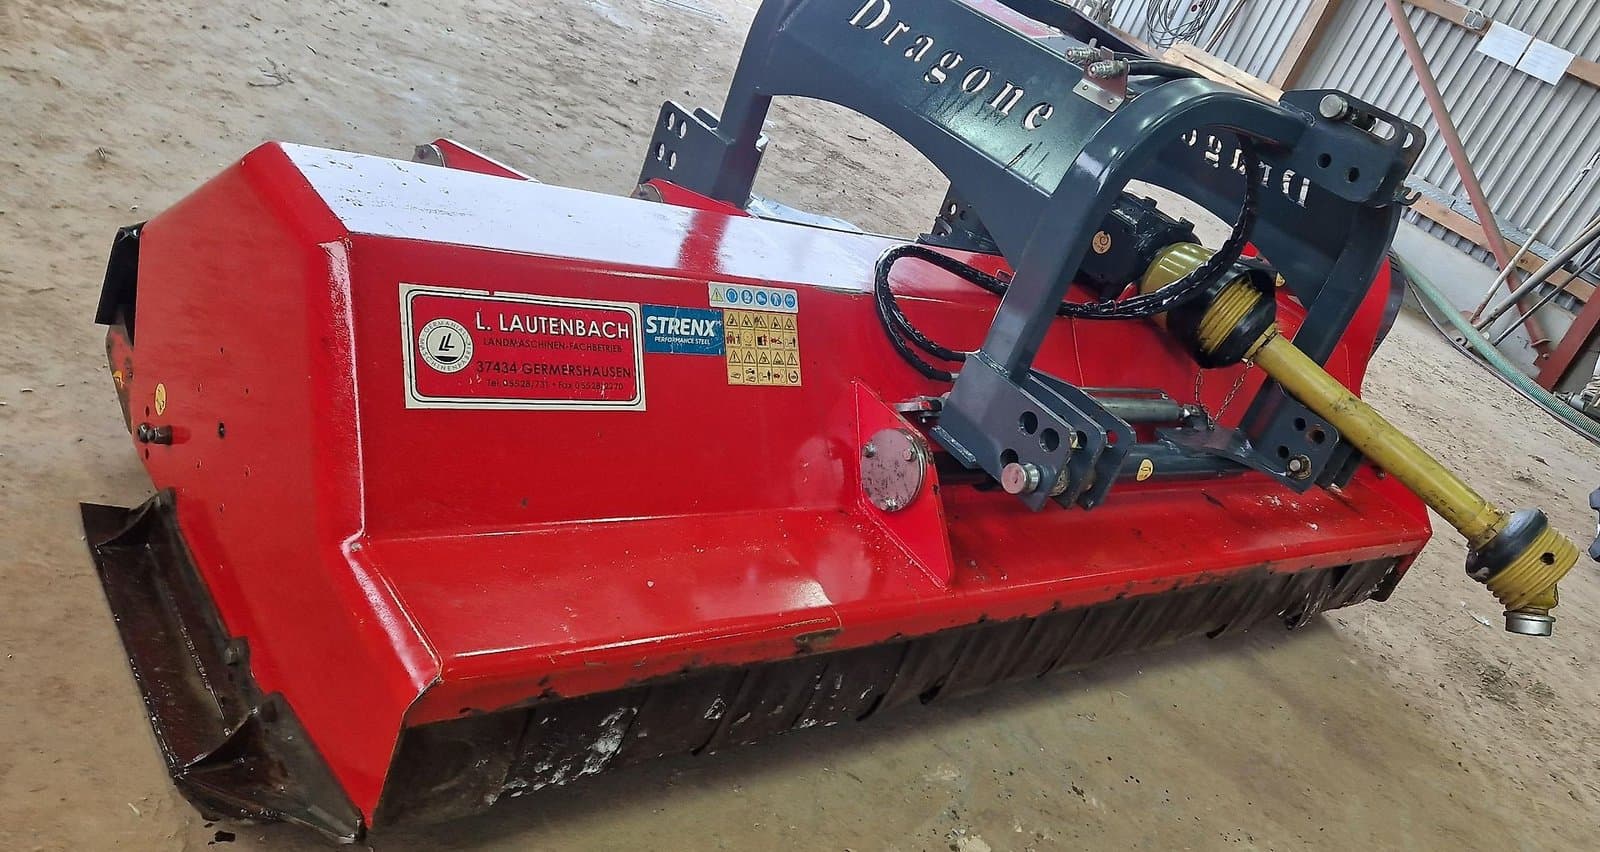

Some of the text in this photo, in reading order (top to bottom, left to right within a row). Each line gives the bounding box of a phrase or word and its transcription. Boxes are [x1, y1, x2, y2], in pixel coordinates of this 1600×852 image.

[848, 0, 1055, 131] Dragone
[475, 311, 629, 339] L. LAUTENBACH
[646, 315, 715, 337] STRENX
[483, 337, 622, 352] LANDMASCHINEN-FACHBETRIEB
[654, 335, 694, 344] PERFORMANCE
[476, 361, 631, 378] 37434 GERMERSHAUSEN
